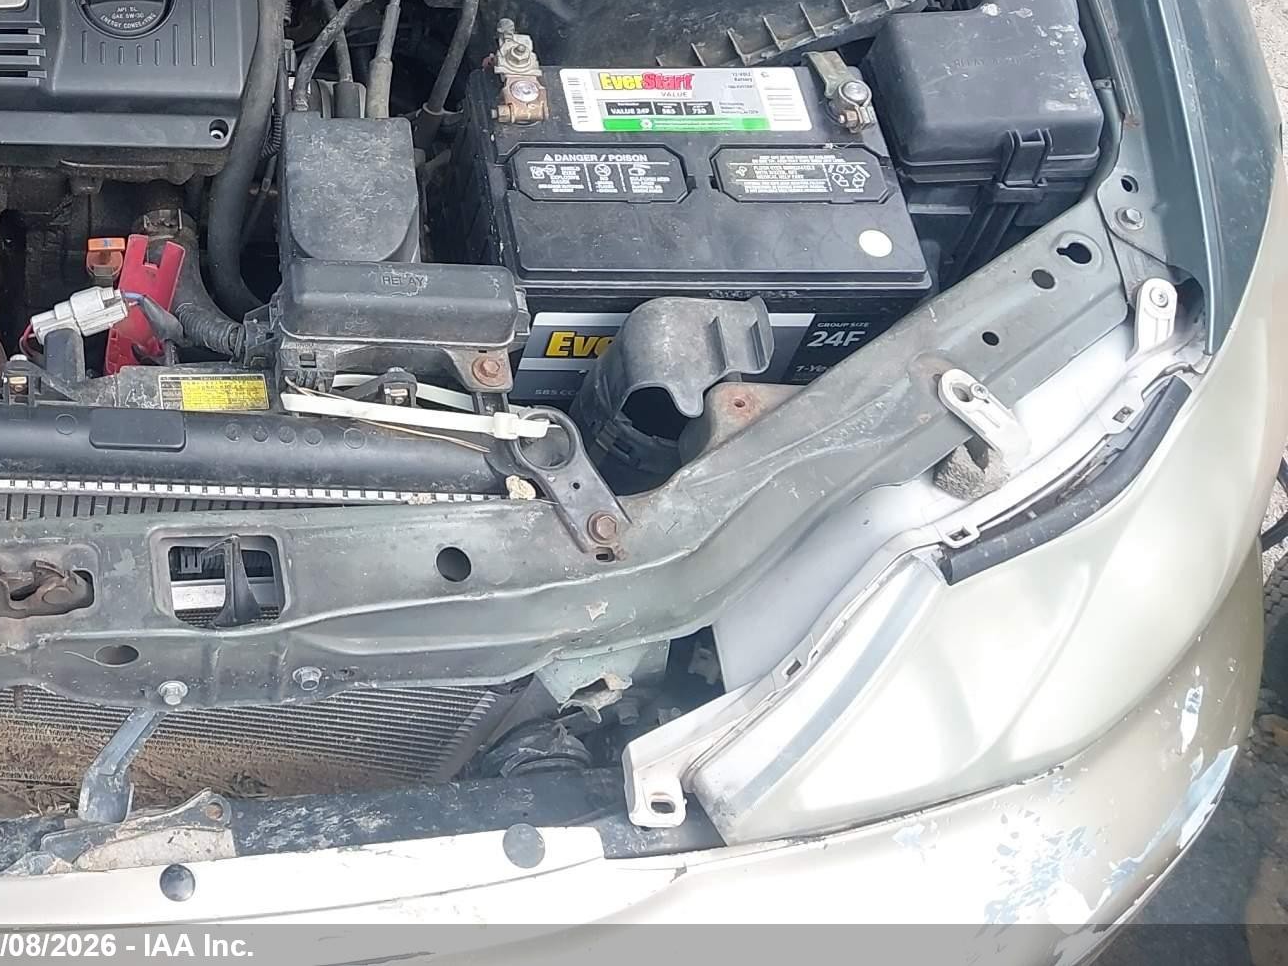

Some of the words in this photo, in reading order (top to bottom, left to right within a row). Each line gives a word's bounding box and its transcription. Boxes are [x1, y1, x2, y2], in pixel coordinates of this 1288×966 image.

[599, 71, 694, 90] EverStart
[554, 153, 598, 162] DANGER
[599, 153, 607, 162] /
[608, 154, 648, 162] POISON
[806, 330, 866, 347] 24F
